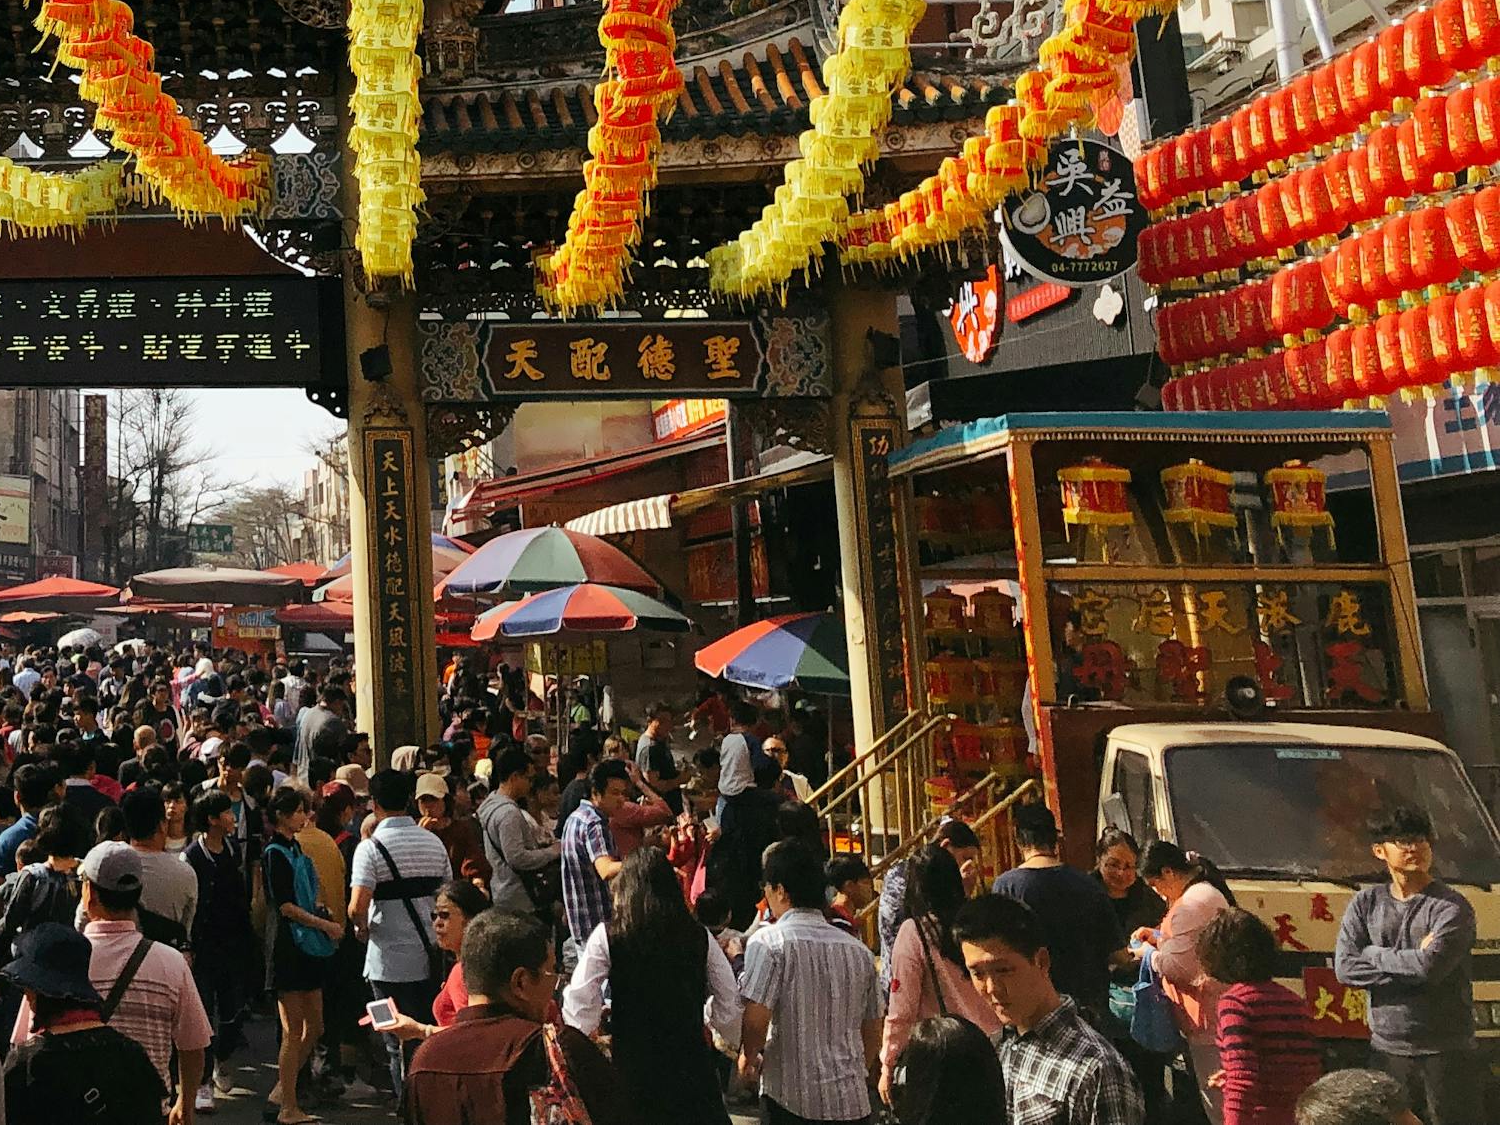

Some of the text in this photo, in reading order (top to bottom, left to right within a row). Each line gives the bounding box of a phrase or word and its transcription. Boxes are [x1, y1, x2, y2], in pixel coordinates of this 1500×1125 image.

[1046, 148, 1134, 245] 吳益興
[502, 334, 742, 381] 聖德配天
